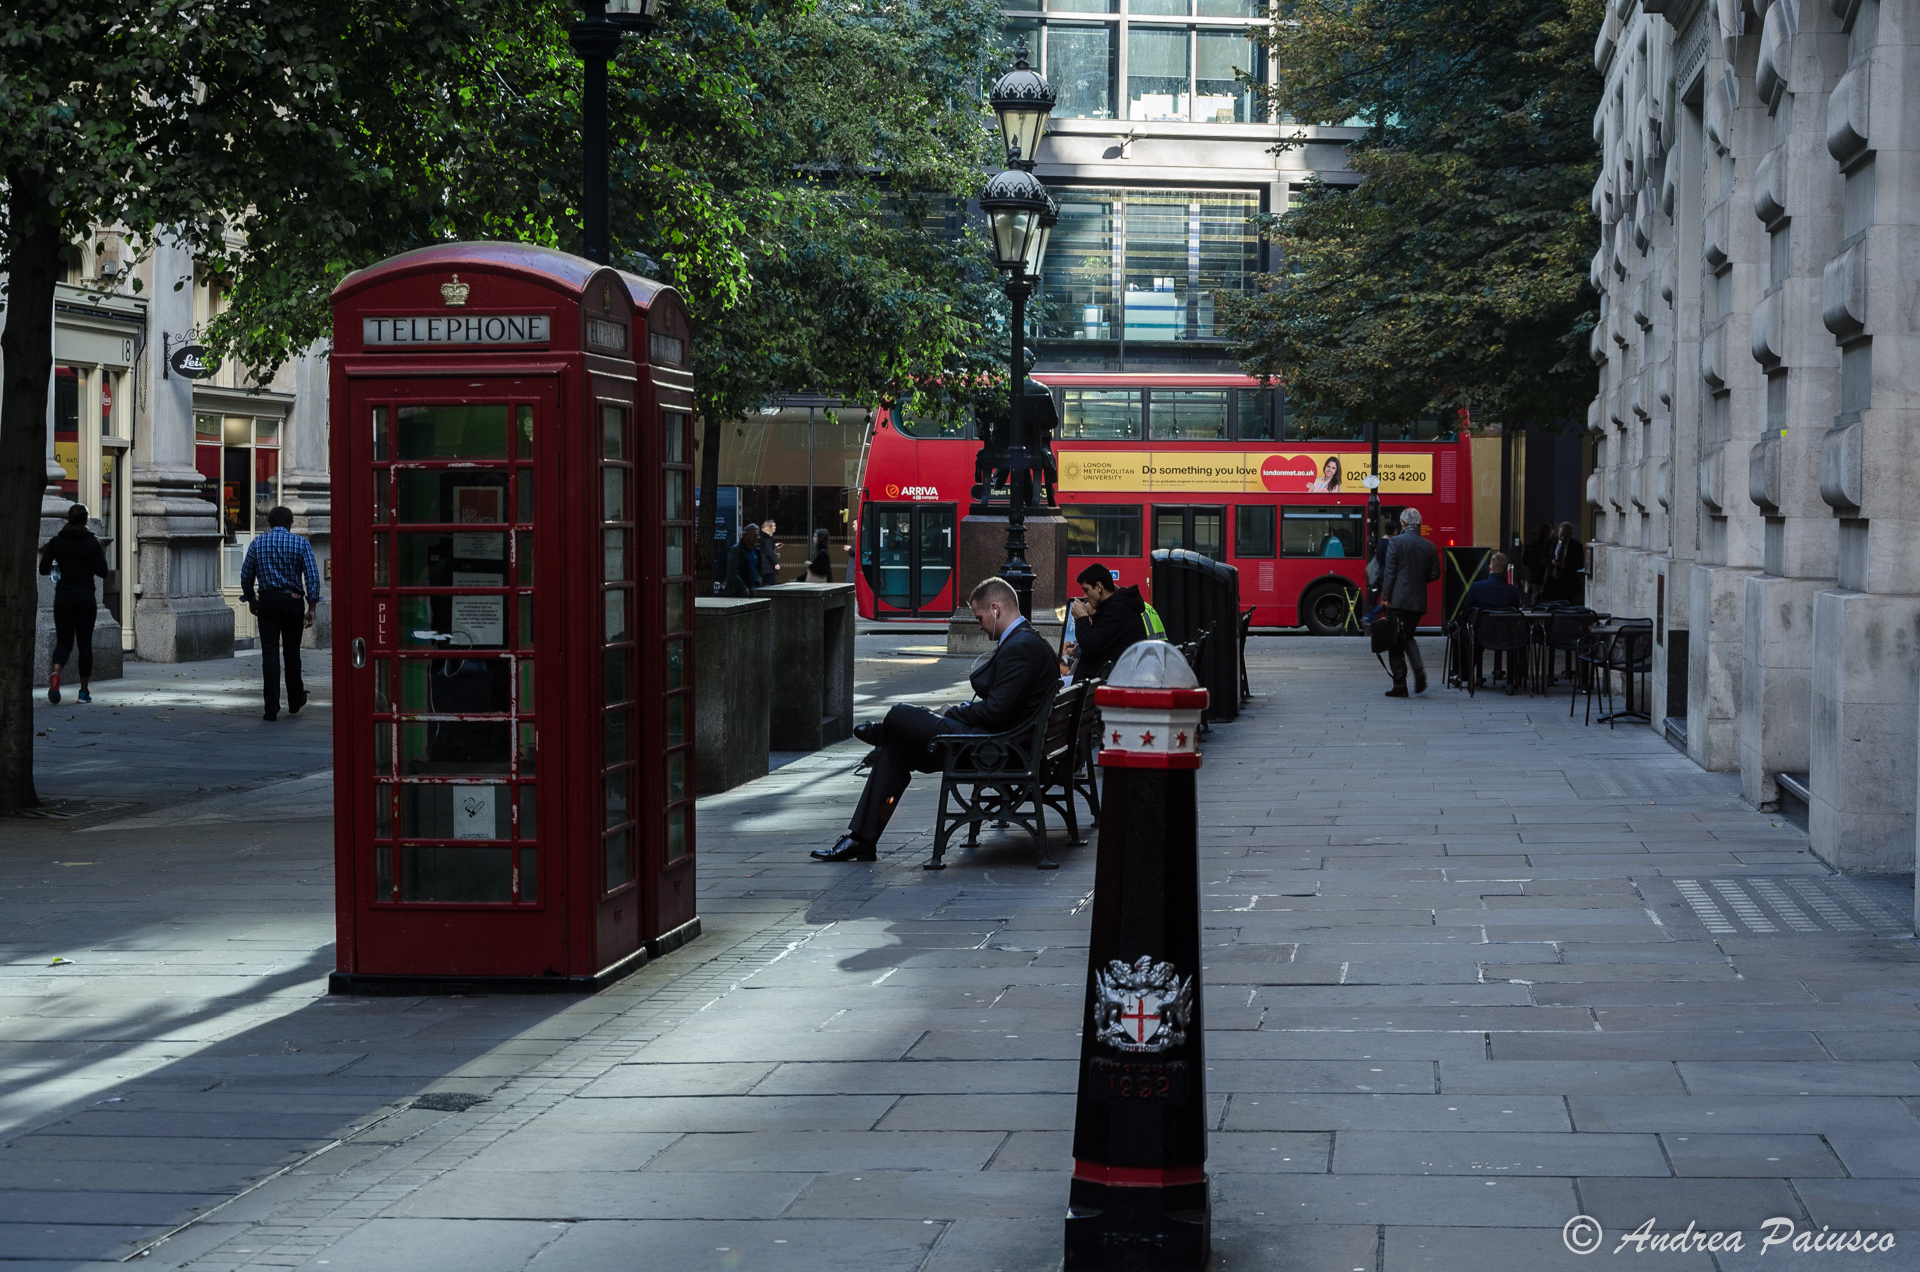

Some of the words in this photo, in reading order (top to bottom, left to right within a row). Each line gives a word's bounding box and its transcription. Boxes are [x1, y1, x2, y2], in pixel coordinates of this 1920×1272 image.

[370, 317, 542, 341] TELEPHONE
[122, 340, 130, 362] 18
[179, 354, 208, 370] Lei
[1142, 465, 1157, 474] Do
[1160, 466, 1212, 476] something
[1215, 467, 1233, 476] you
[1236, 466, 1257, 475] love
[1347, 471, 1367, 481] 020
[1378, 472, 1396, 481] 133
[1399, 472, 1426, 481] 4200
[901, 486, 938, 495] ARRIVA
[1109, 1075, 1170, 1099] 1992
